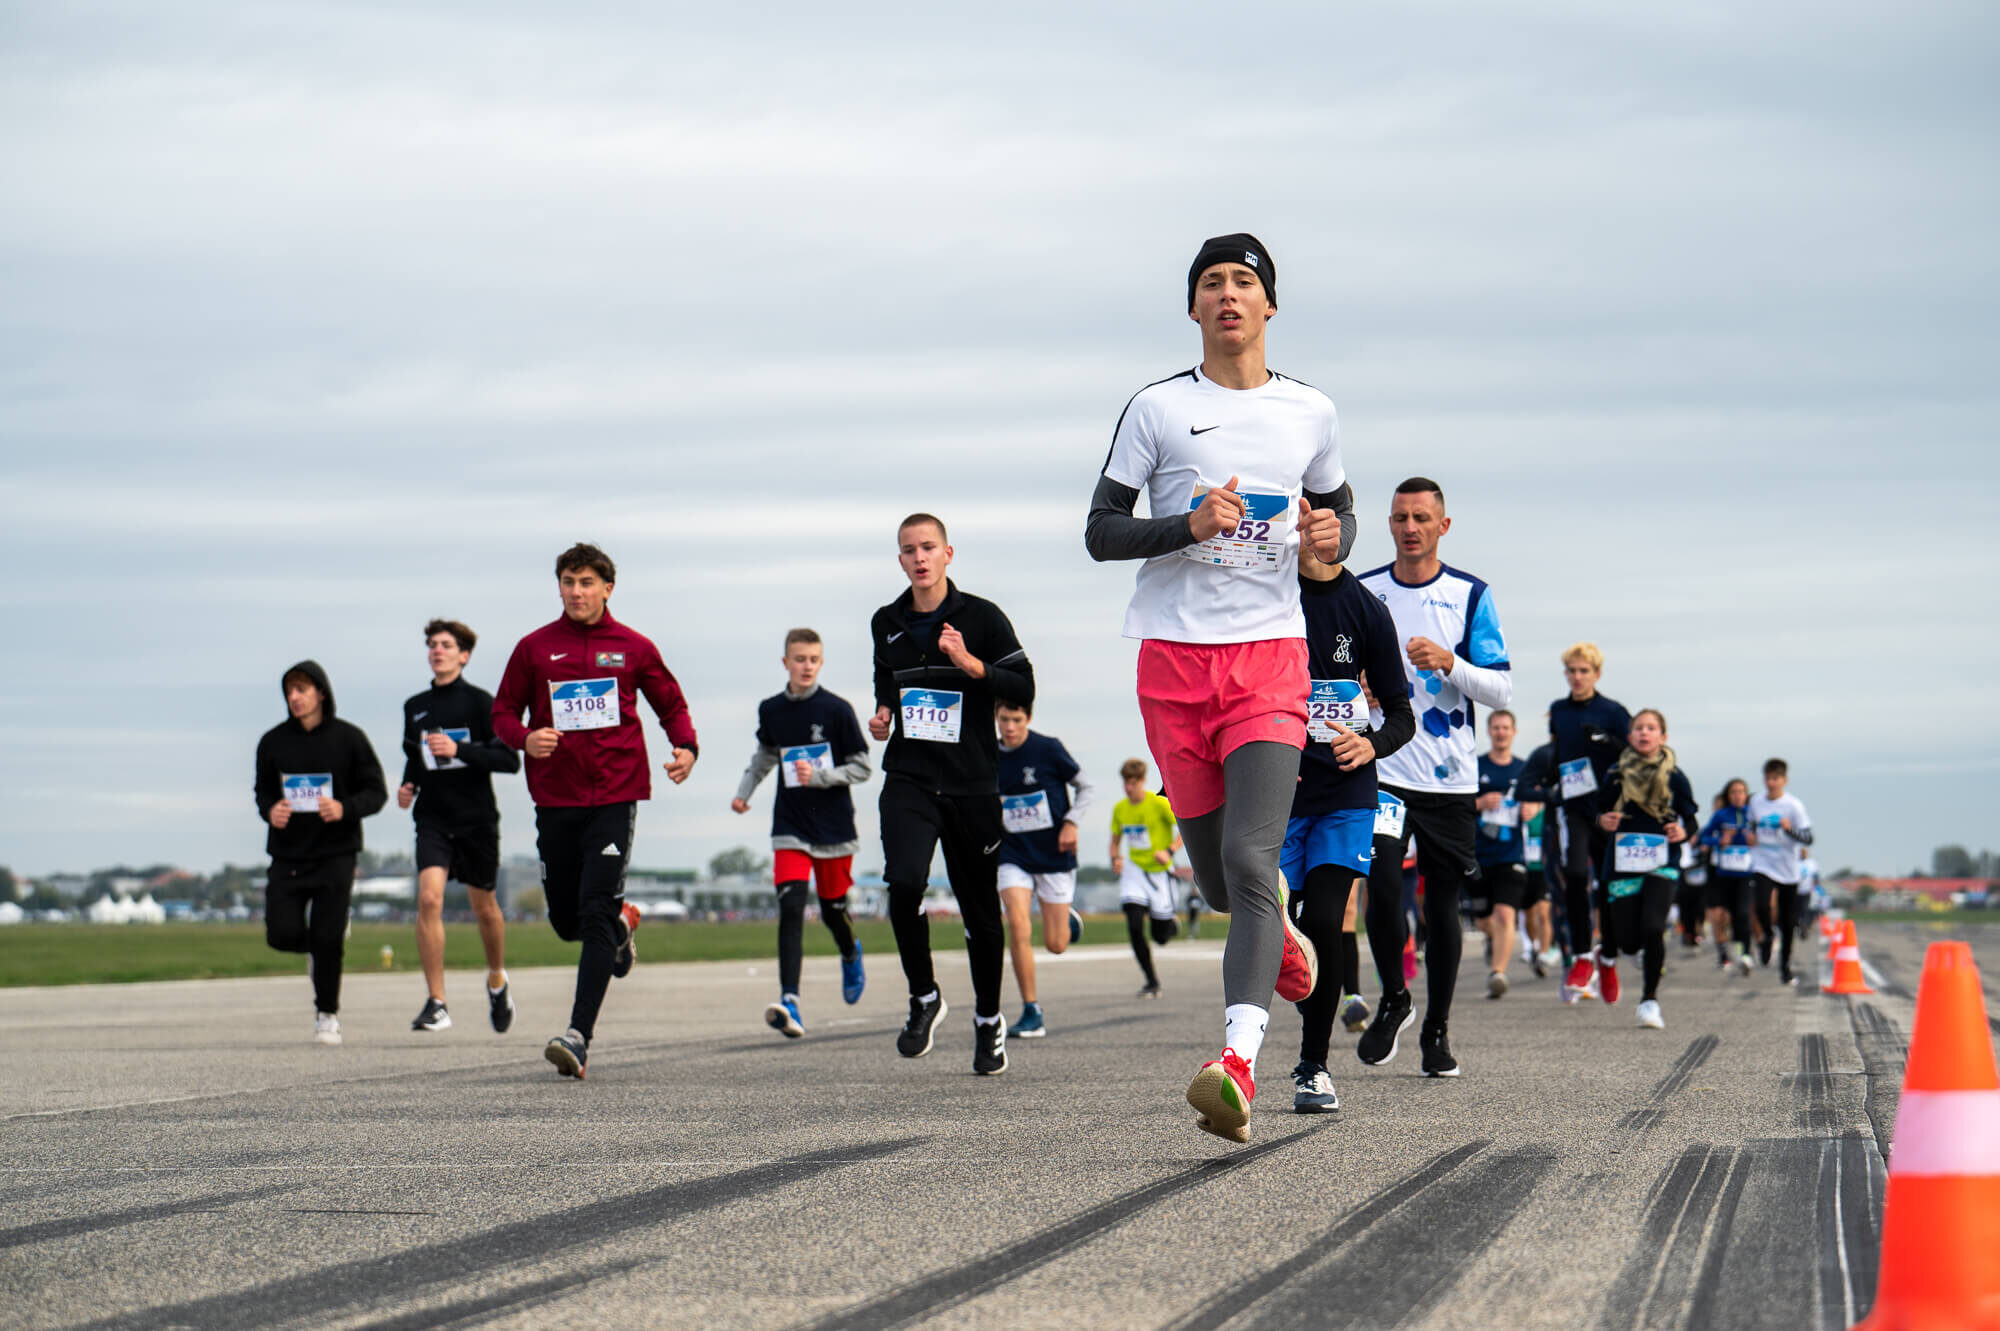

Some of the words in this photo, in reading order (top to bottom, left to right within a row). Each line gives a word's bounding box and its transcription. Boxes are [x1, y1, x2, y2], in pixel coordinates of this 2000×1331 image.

[564, 698, 606, 713] 3108
[905, 706, 948, 723] 3110
[1624, 847, 1657, 858] 3256
